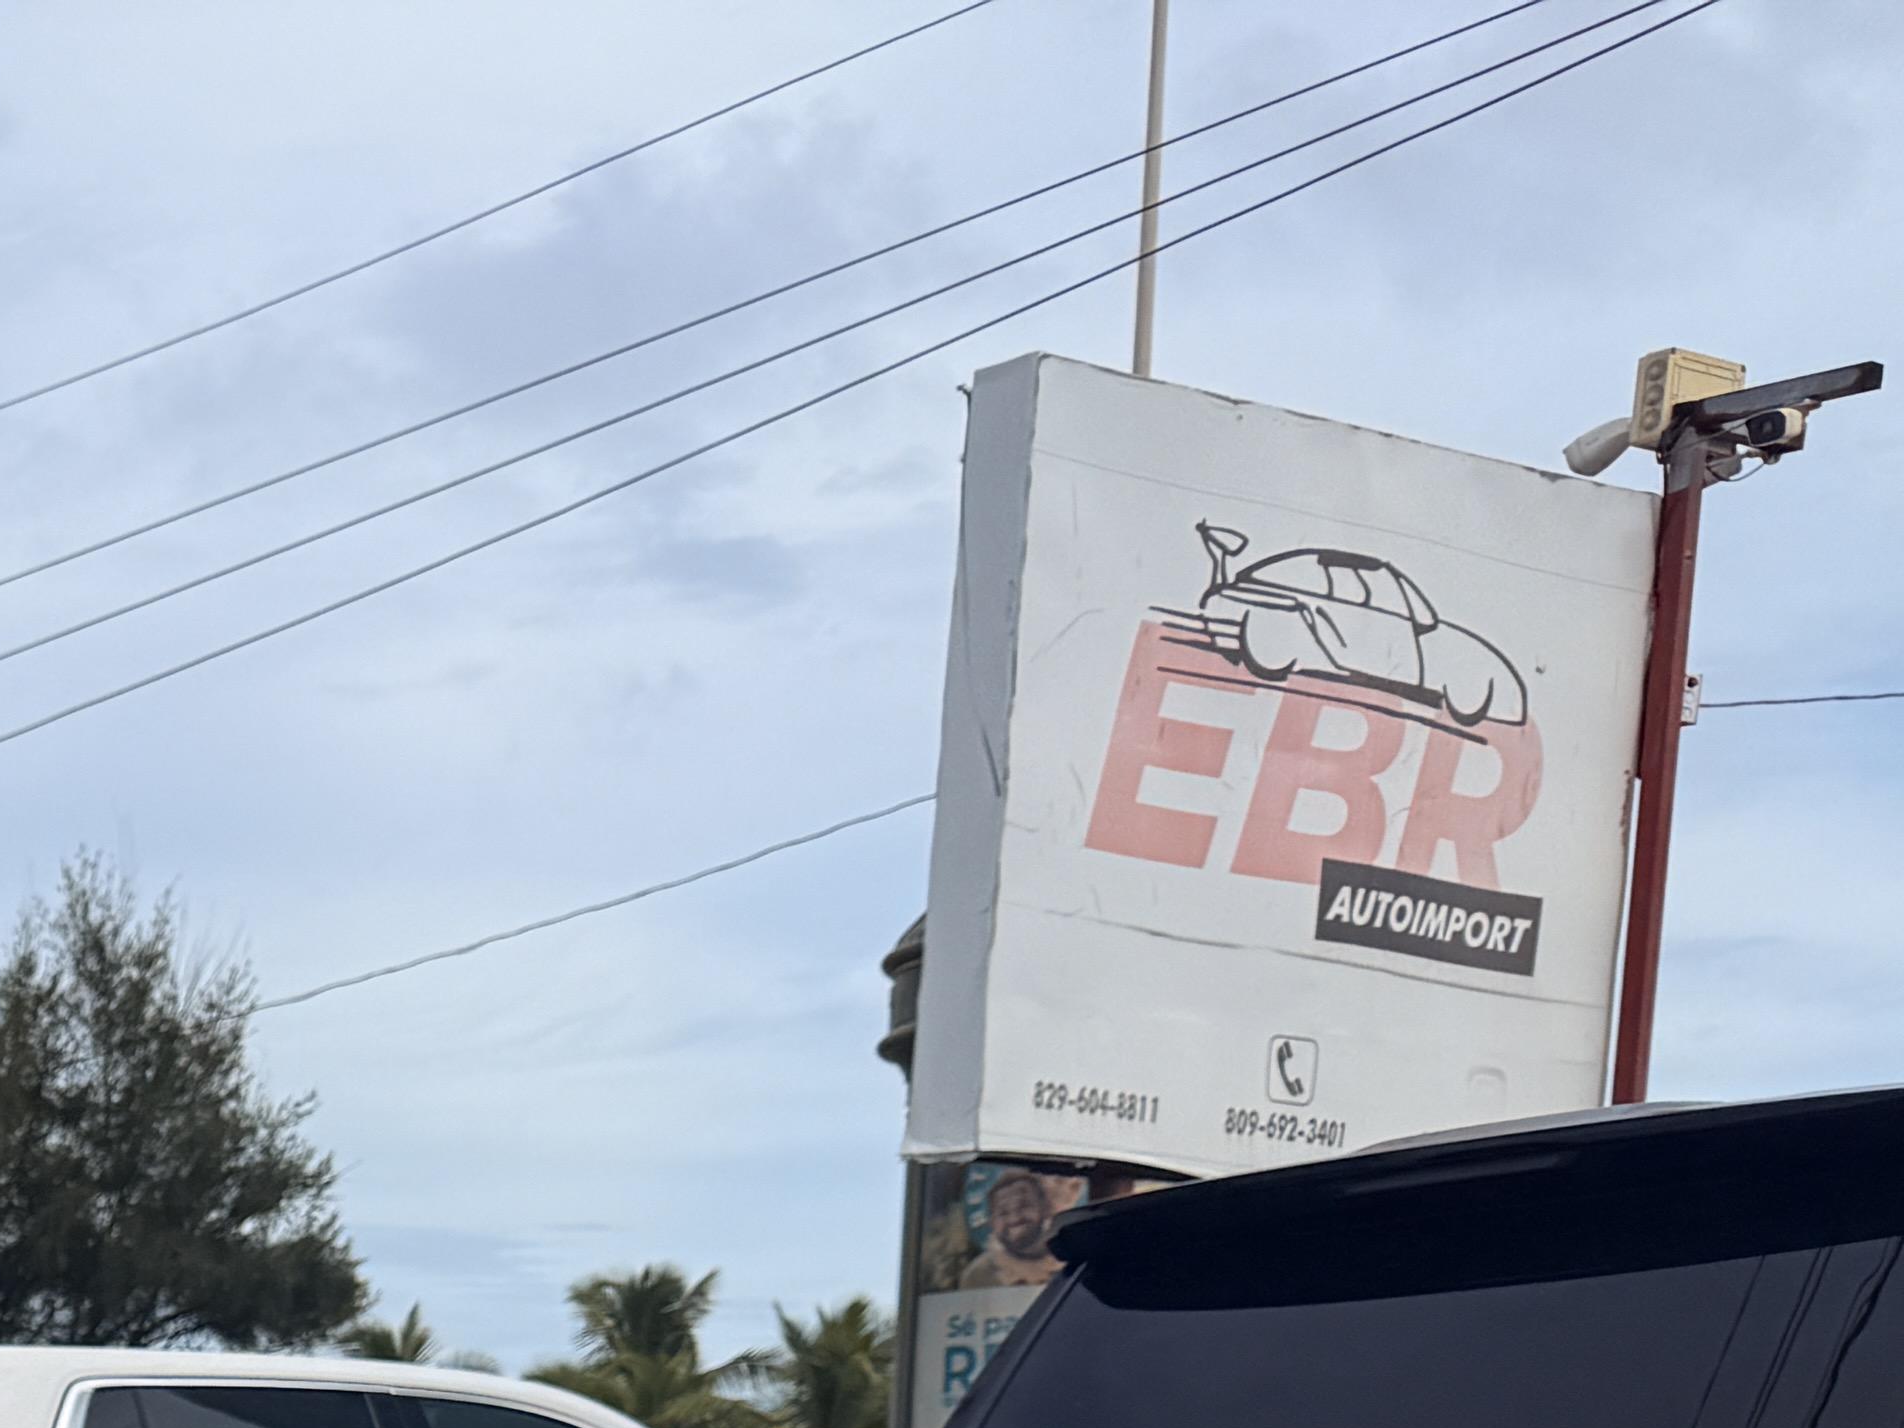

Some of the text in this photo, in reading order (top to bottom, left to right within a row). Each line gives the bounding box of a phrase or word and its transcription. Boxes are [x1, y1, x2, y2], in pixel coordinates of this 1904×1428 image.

[1084, 620, 1543, 888] EBR
[1326, 889, 1533, 955] AUTOIMPORT
[1033, 1080, 1160, 1124] 829-604-8811
[1225, 1107, 1346, 1149] 809-692-3401
